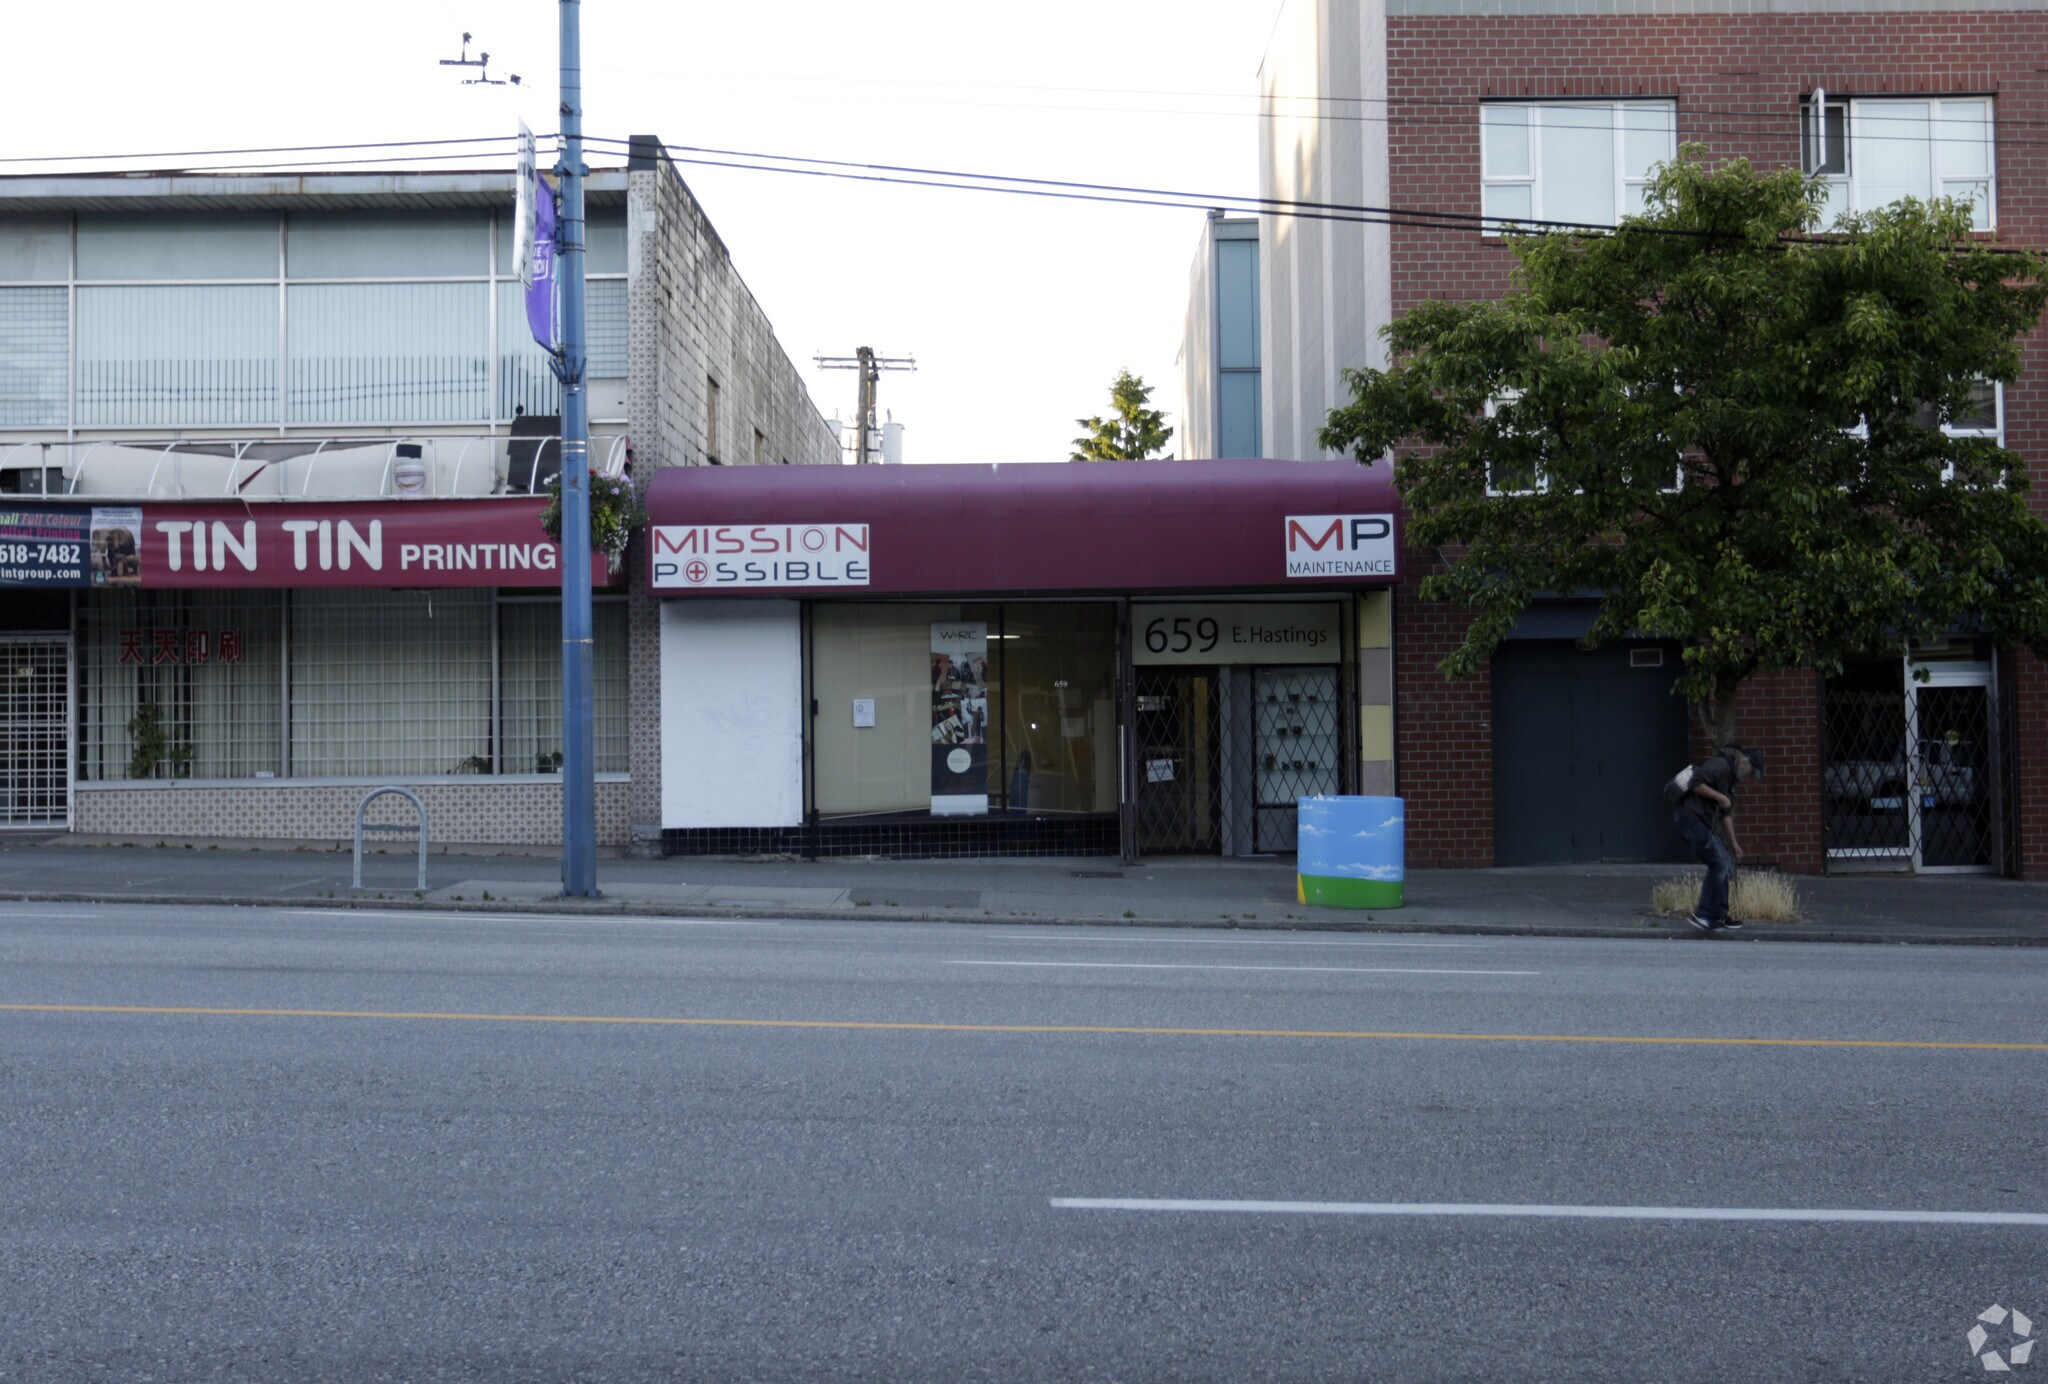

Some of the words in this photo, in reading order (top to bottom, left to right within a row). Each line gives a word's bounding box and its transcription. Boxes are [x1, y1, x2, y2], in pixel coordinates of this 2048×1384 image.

[22, 512, 42, 525] Full
[46, 513, 81, 526] Colour
[37, 528, 80, 541] Printing
[155, 520, 257, 572] TIN
[282, 519, 383, 572] TIN
[401, 543, 556, 570] PRINTING
[654, 526, 867, 554] MISSION
[1289, 519, 1390, 552] MP
[654, 558, 868, 585] POSSIBLE
[1289, 560, 1392, 575] MAINTENANCE
[119, 630, 242, 665] 天天印刷
[1145, 617, 1219, 653] 659
[1251, 626, 1327, 647] Hastings
[1054, 680, 1068, 688] 659
